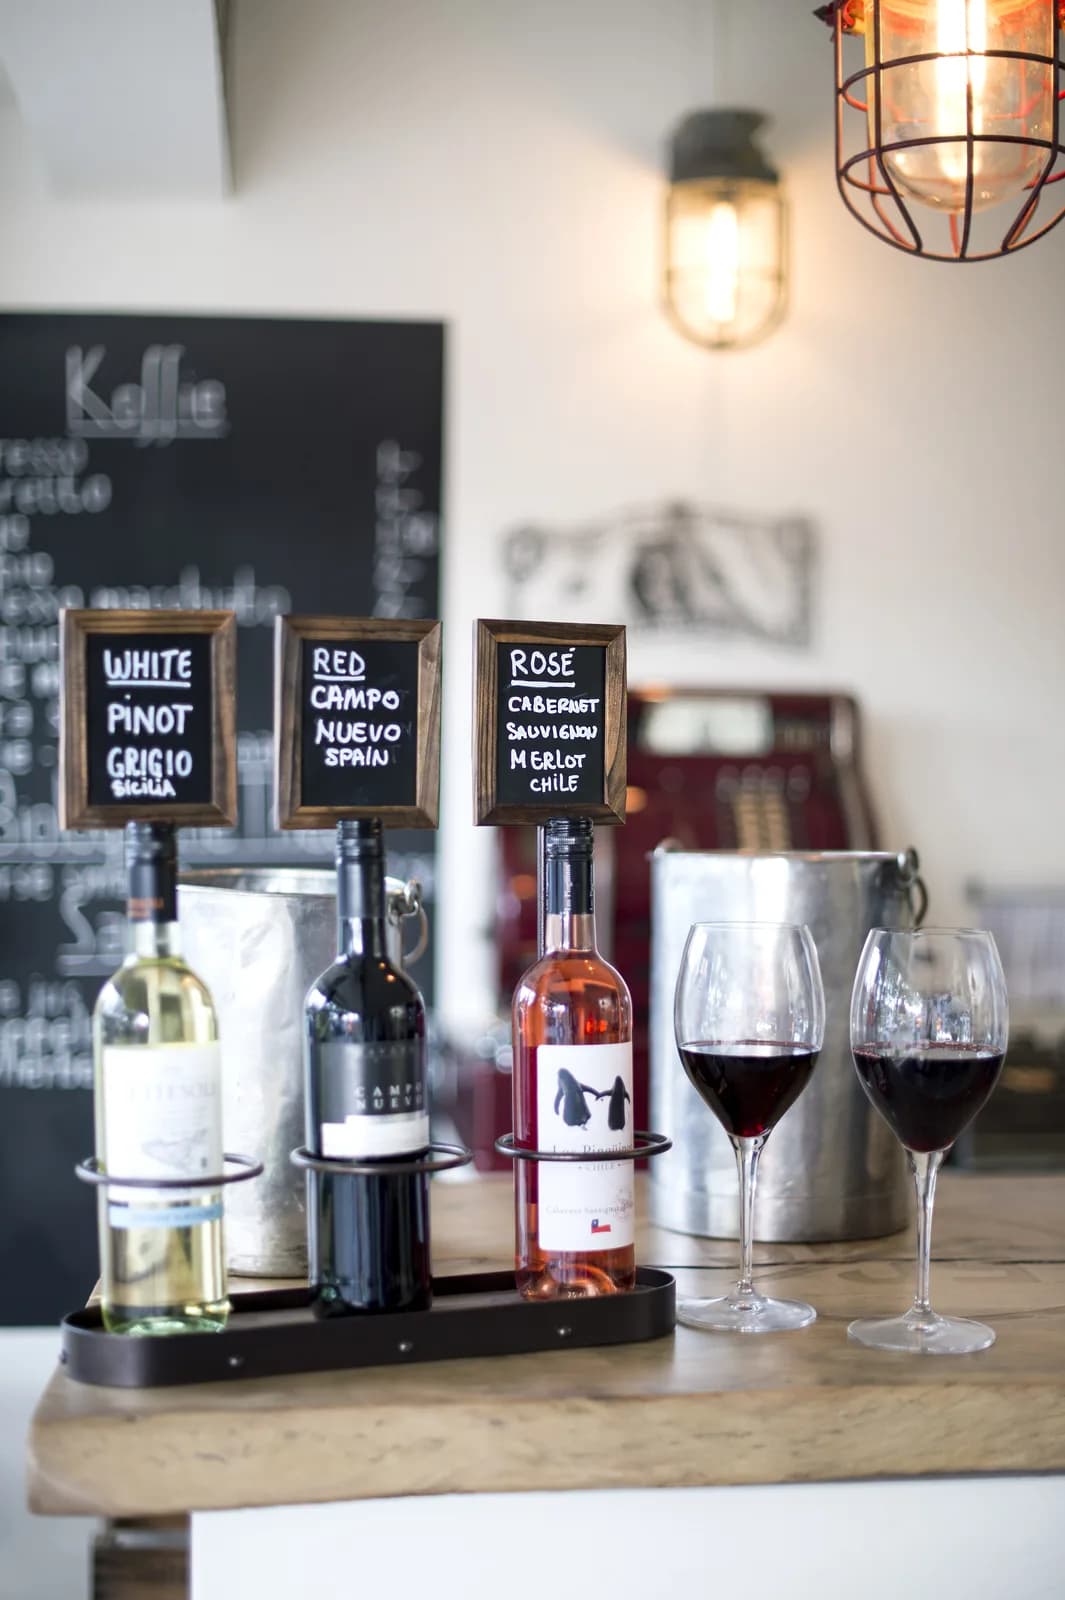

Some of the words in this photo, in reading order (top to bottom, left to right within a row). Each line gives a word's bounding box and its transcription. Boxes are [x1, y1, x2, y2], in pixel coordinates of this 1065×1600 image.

[103, 649, 192, 680] WHITE
[313, 647, 366, 676] RED
[510, 647, 576, 677] ROSÉ
[310, 685, 400, 711] CAMPO
[508, 695, 600, 714] CABERNET
[315, 719, 401, 745] NUEVO
[506, 722, 598, 741] SAUVIGNON
[106, 747, 193, 778] GRIGIO
[324, 746, 389, 767] SPAIN
[510, 748, 586, 771] MERLOT
